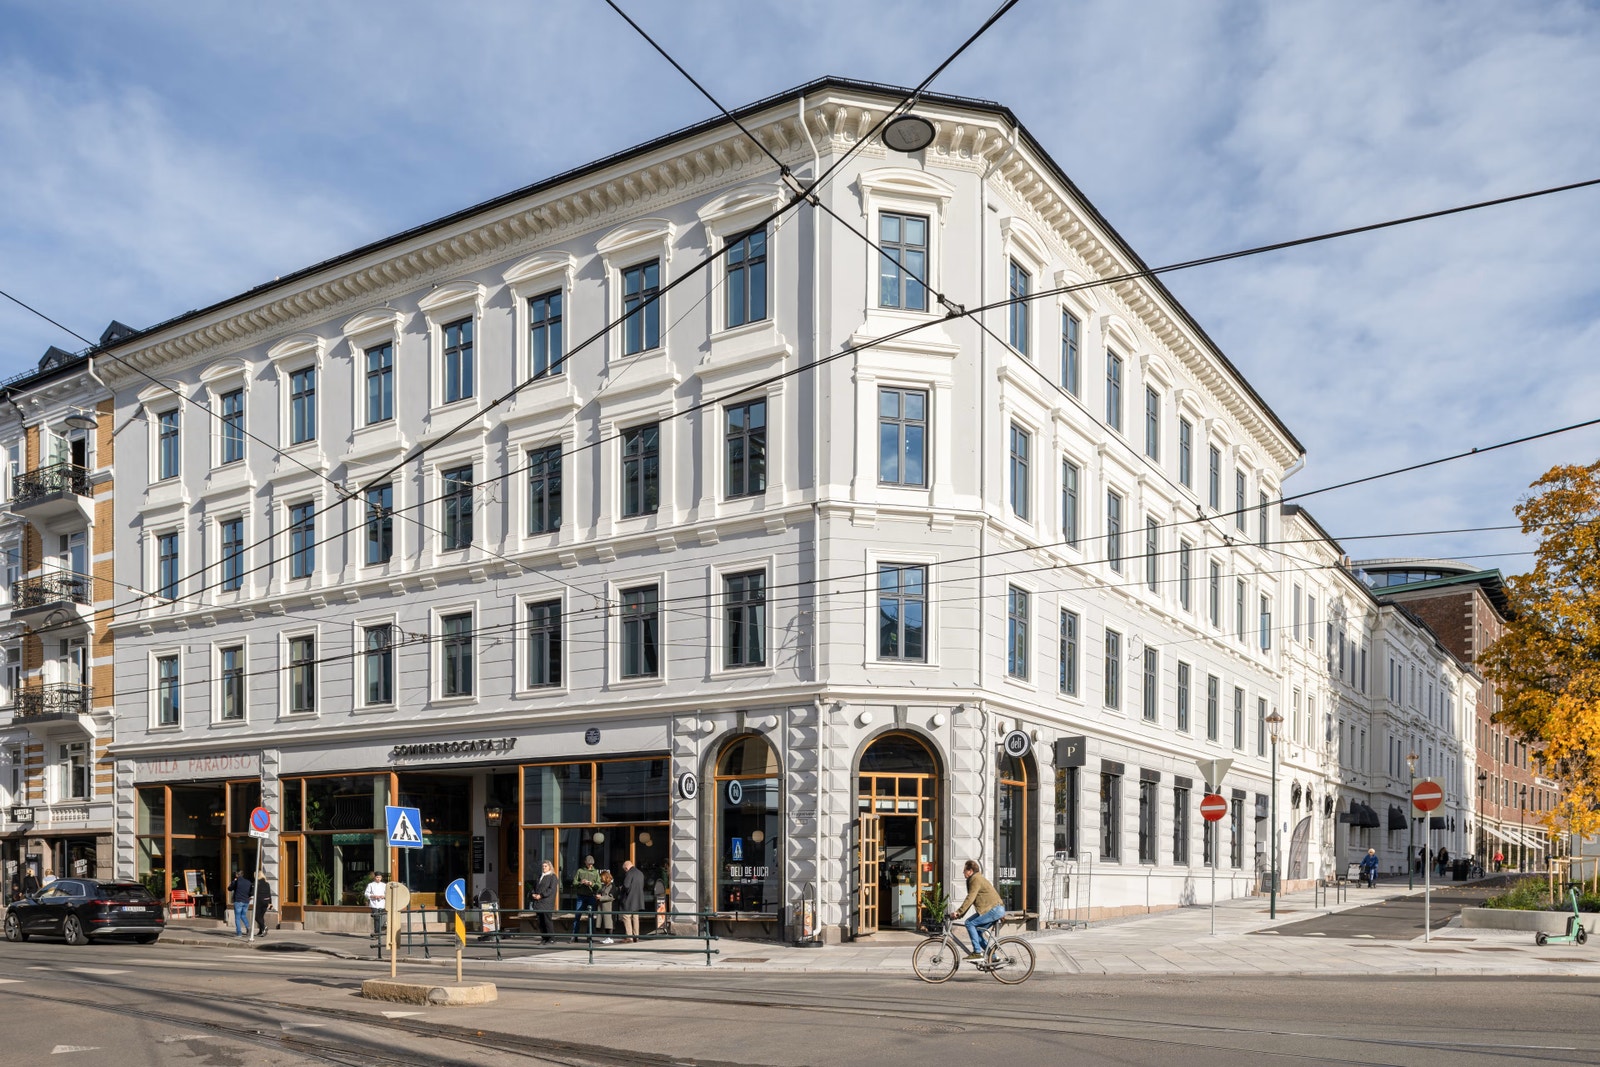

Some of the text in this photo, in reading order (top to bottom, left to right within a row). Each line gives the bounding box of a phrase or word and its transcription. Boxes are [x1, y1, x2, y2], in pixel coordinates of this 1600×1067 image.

[393, 737, 517, 756] SOMMERROGATA 17
[1010, 736, 1022, 749] deli
[146, 753, 251, 774] VILLA PARADISO
[730, 866, 769, 877] DELI DE LUCA
